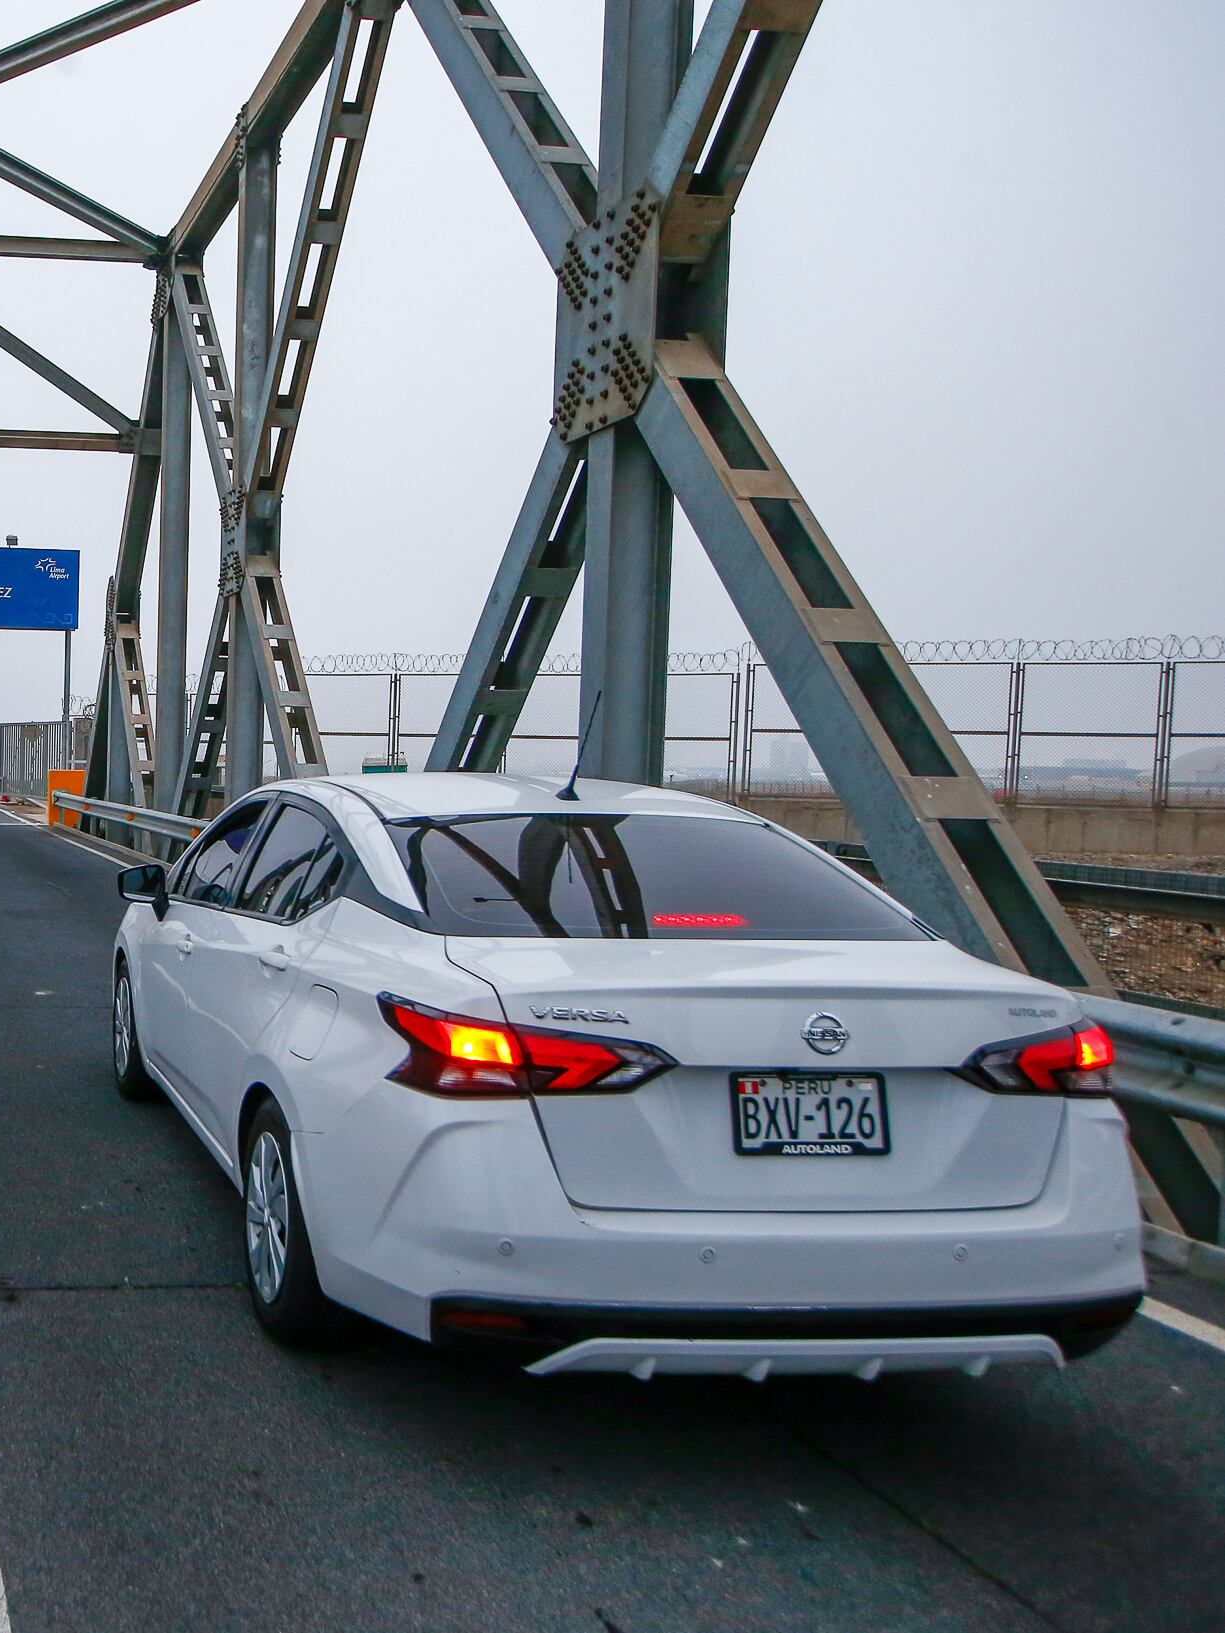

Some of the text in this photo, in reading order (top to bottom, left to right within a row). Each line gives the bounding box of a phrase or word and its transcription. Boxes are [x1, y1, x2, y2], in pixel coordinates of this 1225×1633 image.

[529, 1005, 630, 1024] VERSA
[1008, 1007, 1057, 1018] AUTOLAND
[807, 1029, 846, 1038] NISSAN
[742, 1096, 876, 1140] BXV-126
[782, 1144, 852, 1154] AUTOLAND
